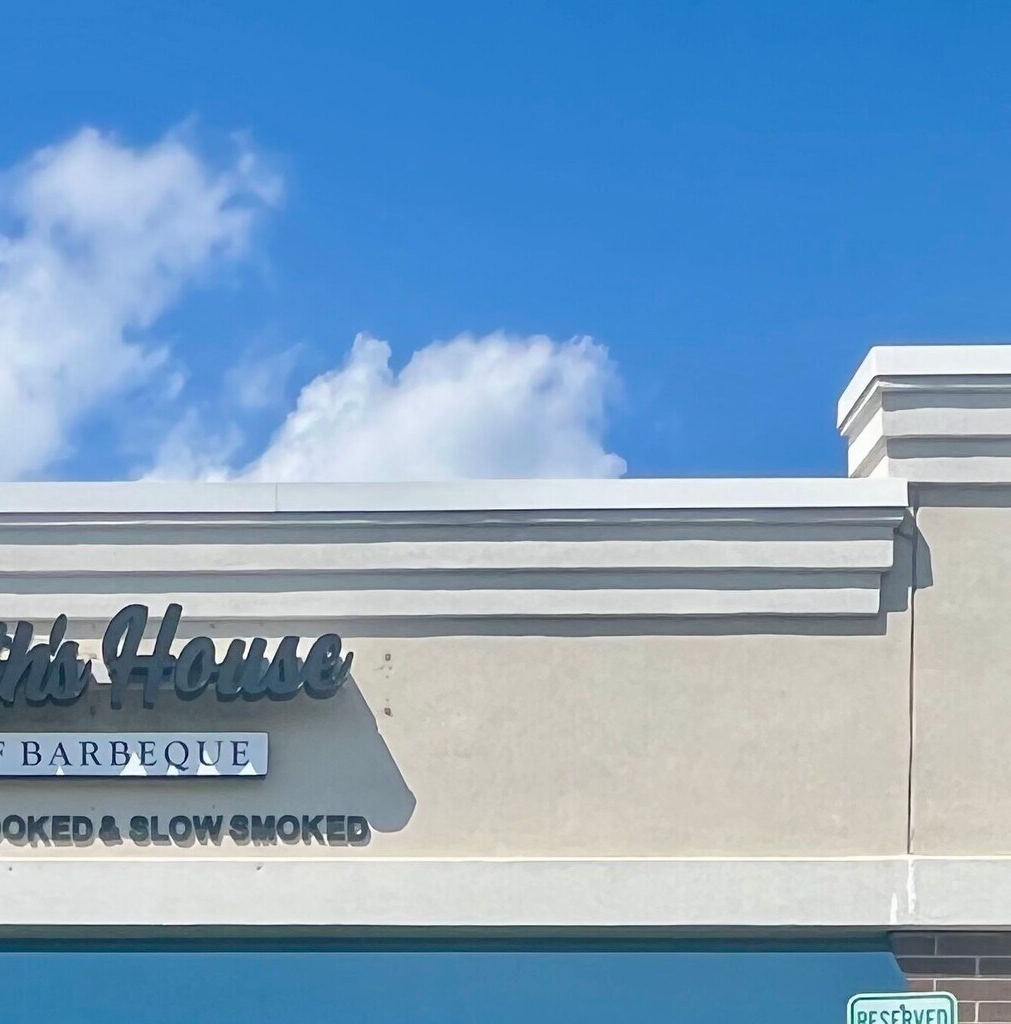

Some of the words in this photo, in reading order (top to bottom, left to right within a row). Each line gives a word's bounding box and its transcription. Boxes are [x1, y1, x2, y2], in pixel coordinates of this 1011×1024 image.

[102, 603, 354, 710] House
[21, 741, 250, 771] BARBEQUE
[99, 815, 123, 846] &
[129, 815, 223, 847] SLOW
[229, 815, 371, 847] SMOKED
